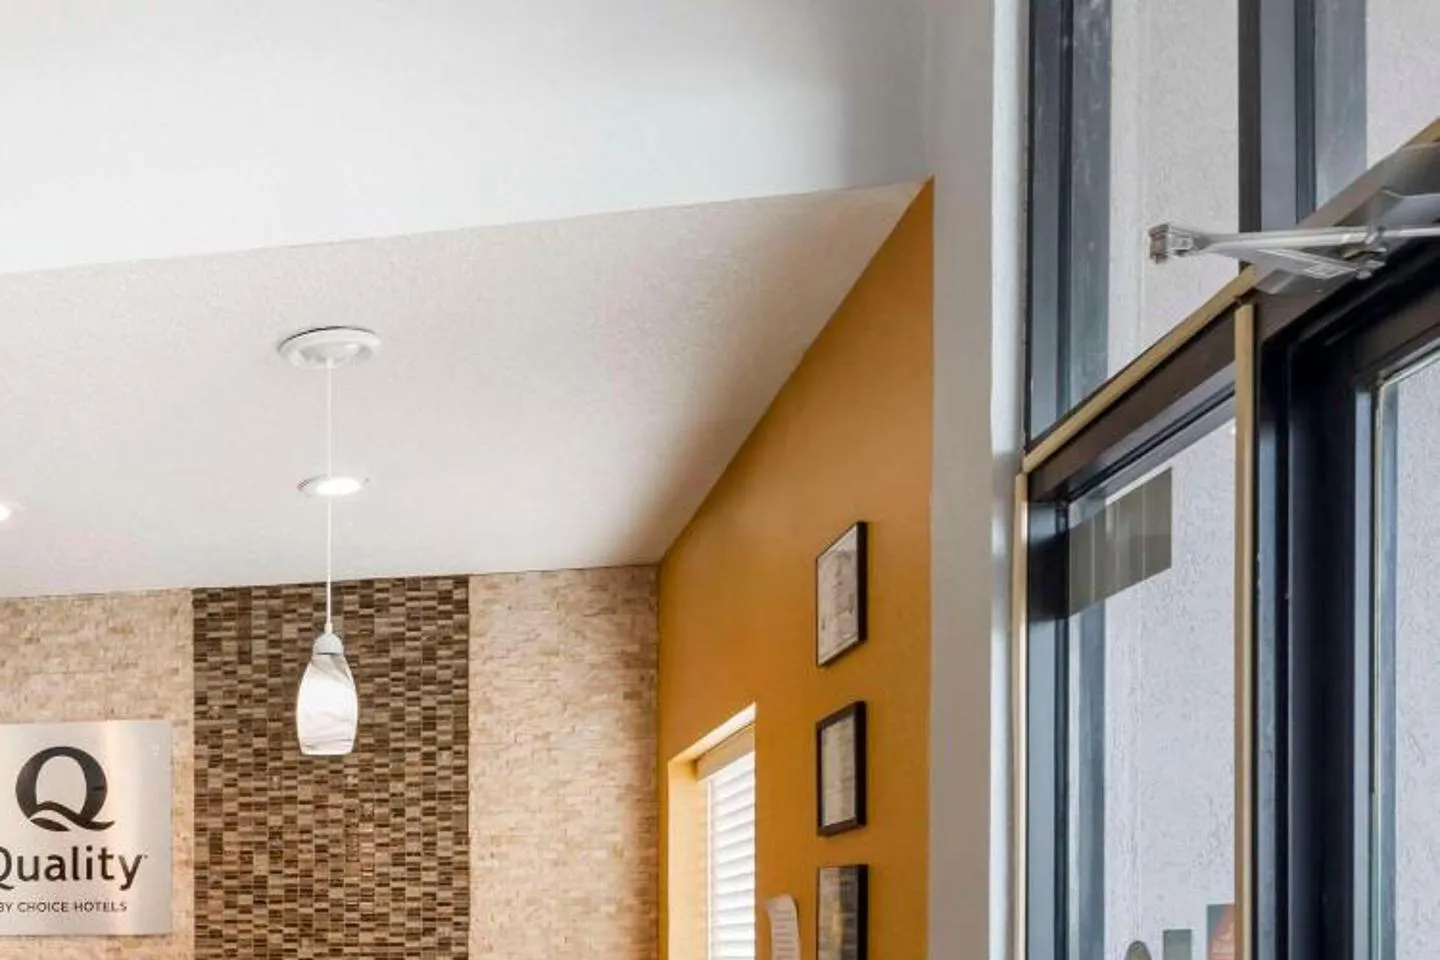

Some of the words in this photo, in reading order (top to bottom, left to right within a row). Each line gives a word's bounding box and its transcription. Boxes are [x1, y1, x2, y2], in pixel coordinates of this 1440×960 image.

[15, 746, 115, 832] Q
[17, 902, 69, 913] CHOICE
[74, 901, 128, 913] HOTELS
